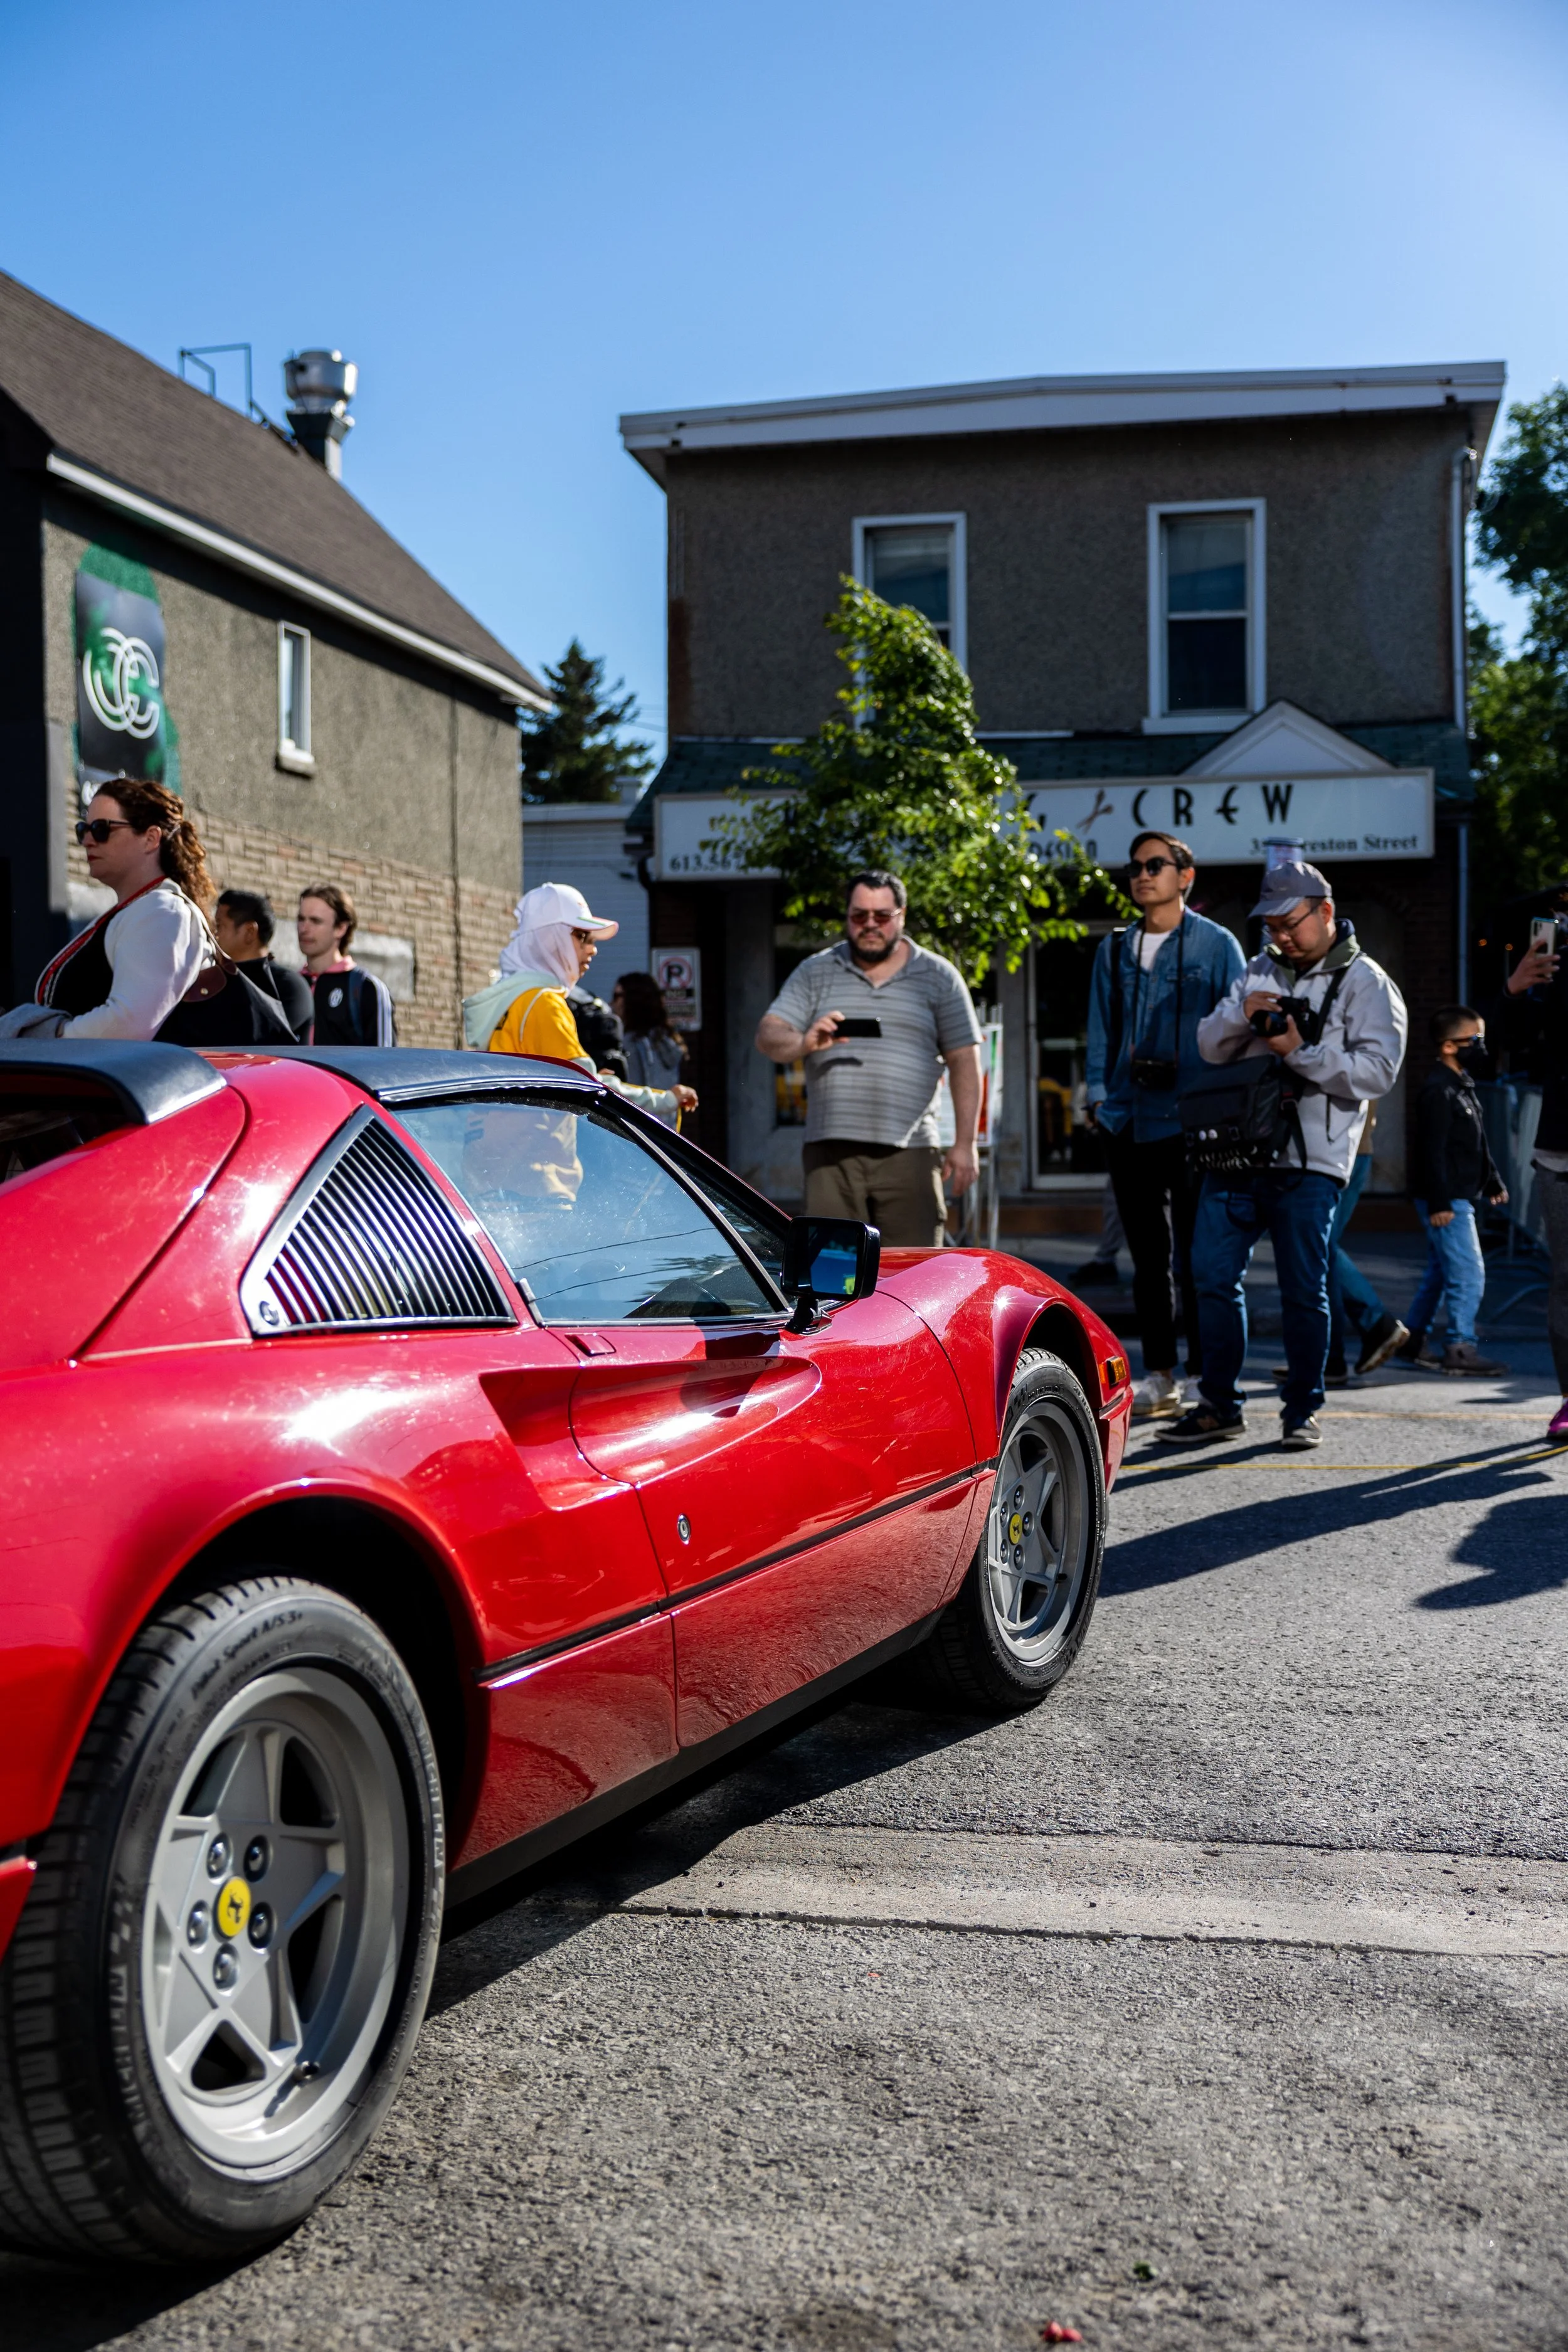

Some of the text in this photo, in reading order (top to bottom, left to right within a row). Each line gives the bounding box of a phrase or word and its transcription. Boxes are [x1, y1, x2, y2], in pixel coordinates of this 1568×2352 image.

[1132, 783, 1294, 827] CREW
[1300, 834, 1418, 852] reston Street
